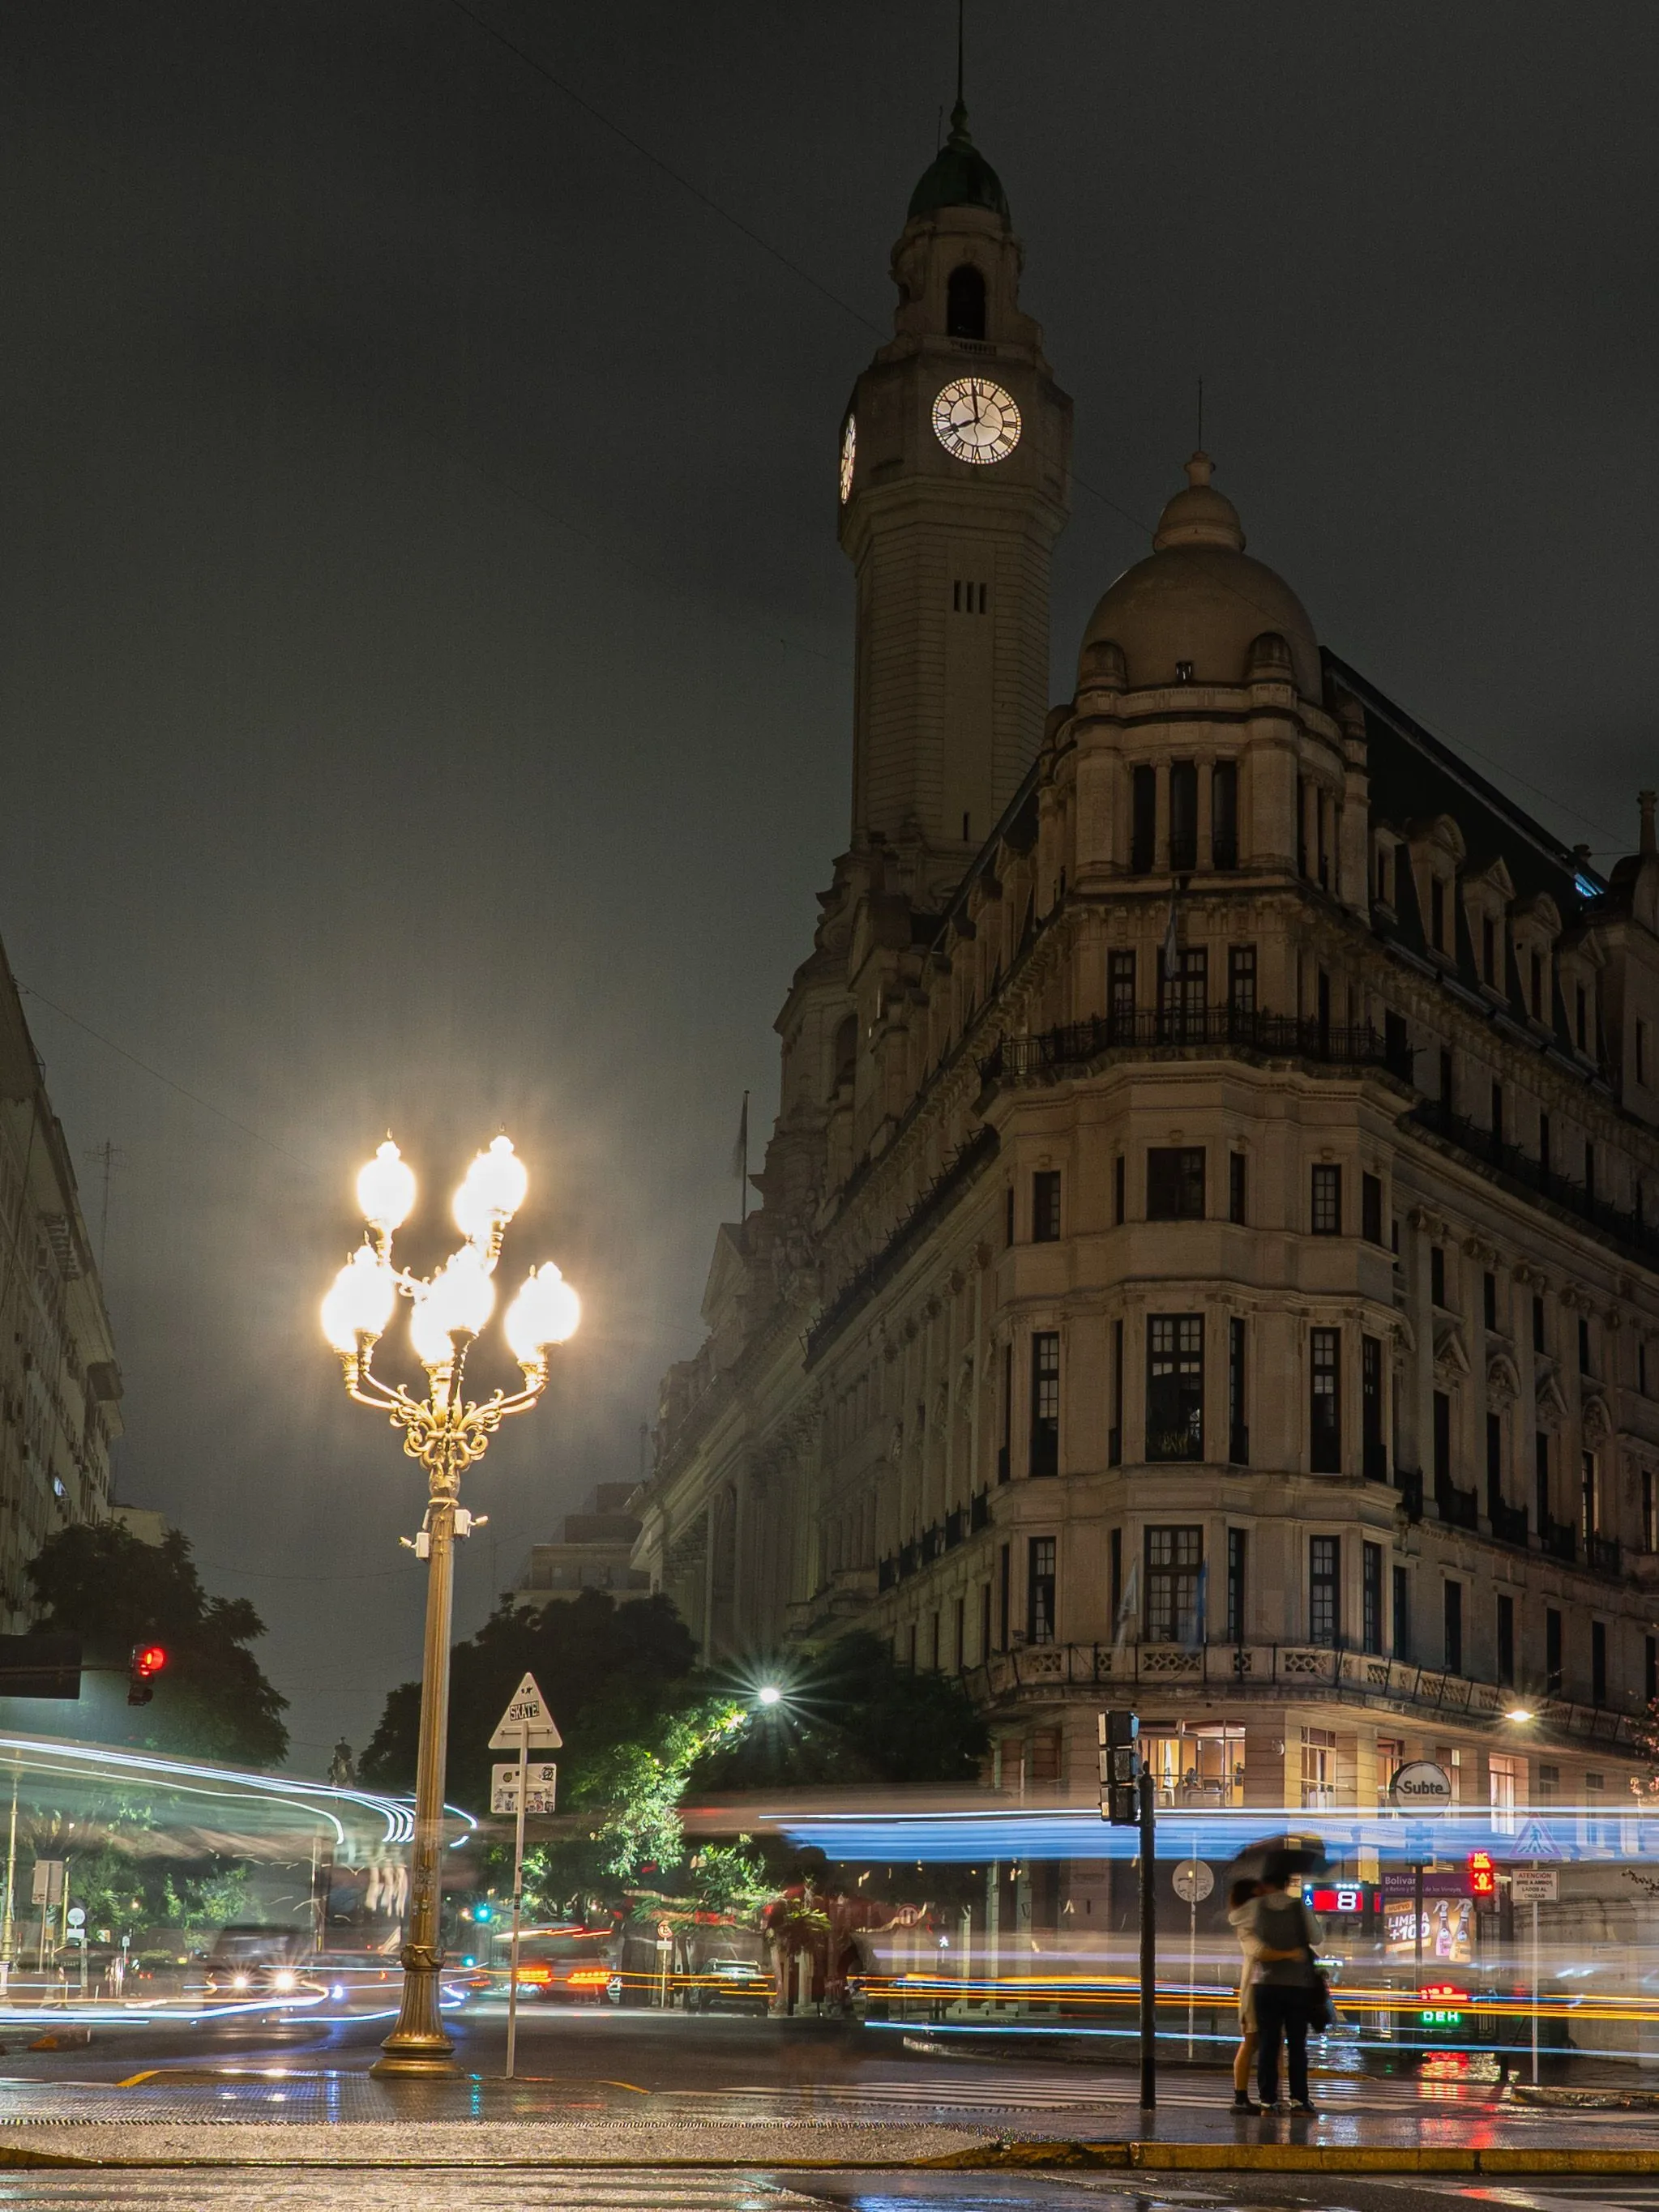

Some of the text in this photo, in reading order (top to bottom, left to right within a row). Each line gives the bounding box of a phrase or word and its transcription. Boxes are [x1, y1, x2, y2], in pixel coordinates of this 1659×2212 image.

[1403, 1780, 1444, 1795] Subte
[1337, 1891, 1356, 1910] 8
[1388, 1912, 1430, 1928] LIMPA
